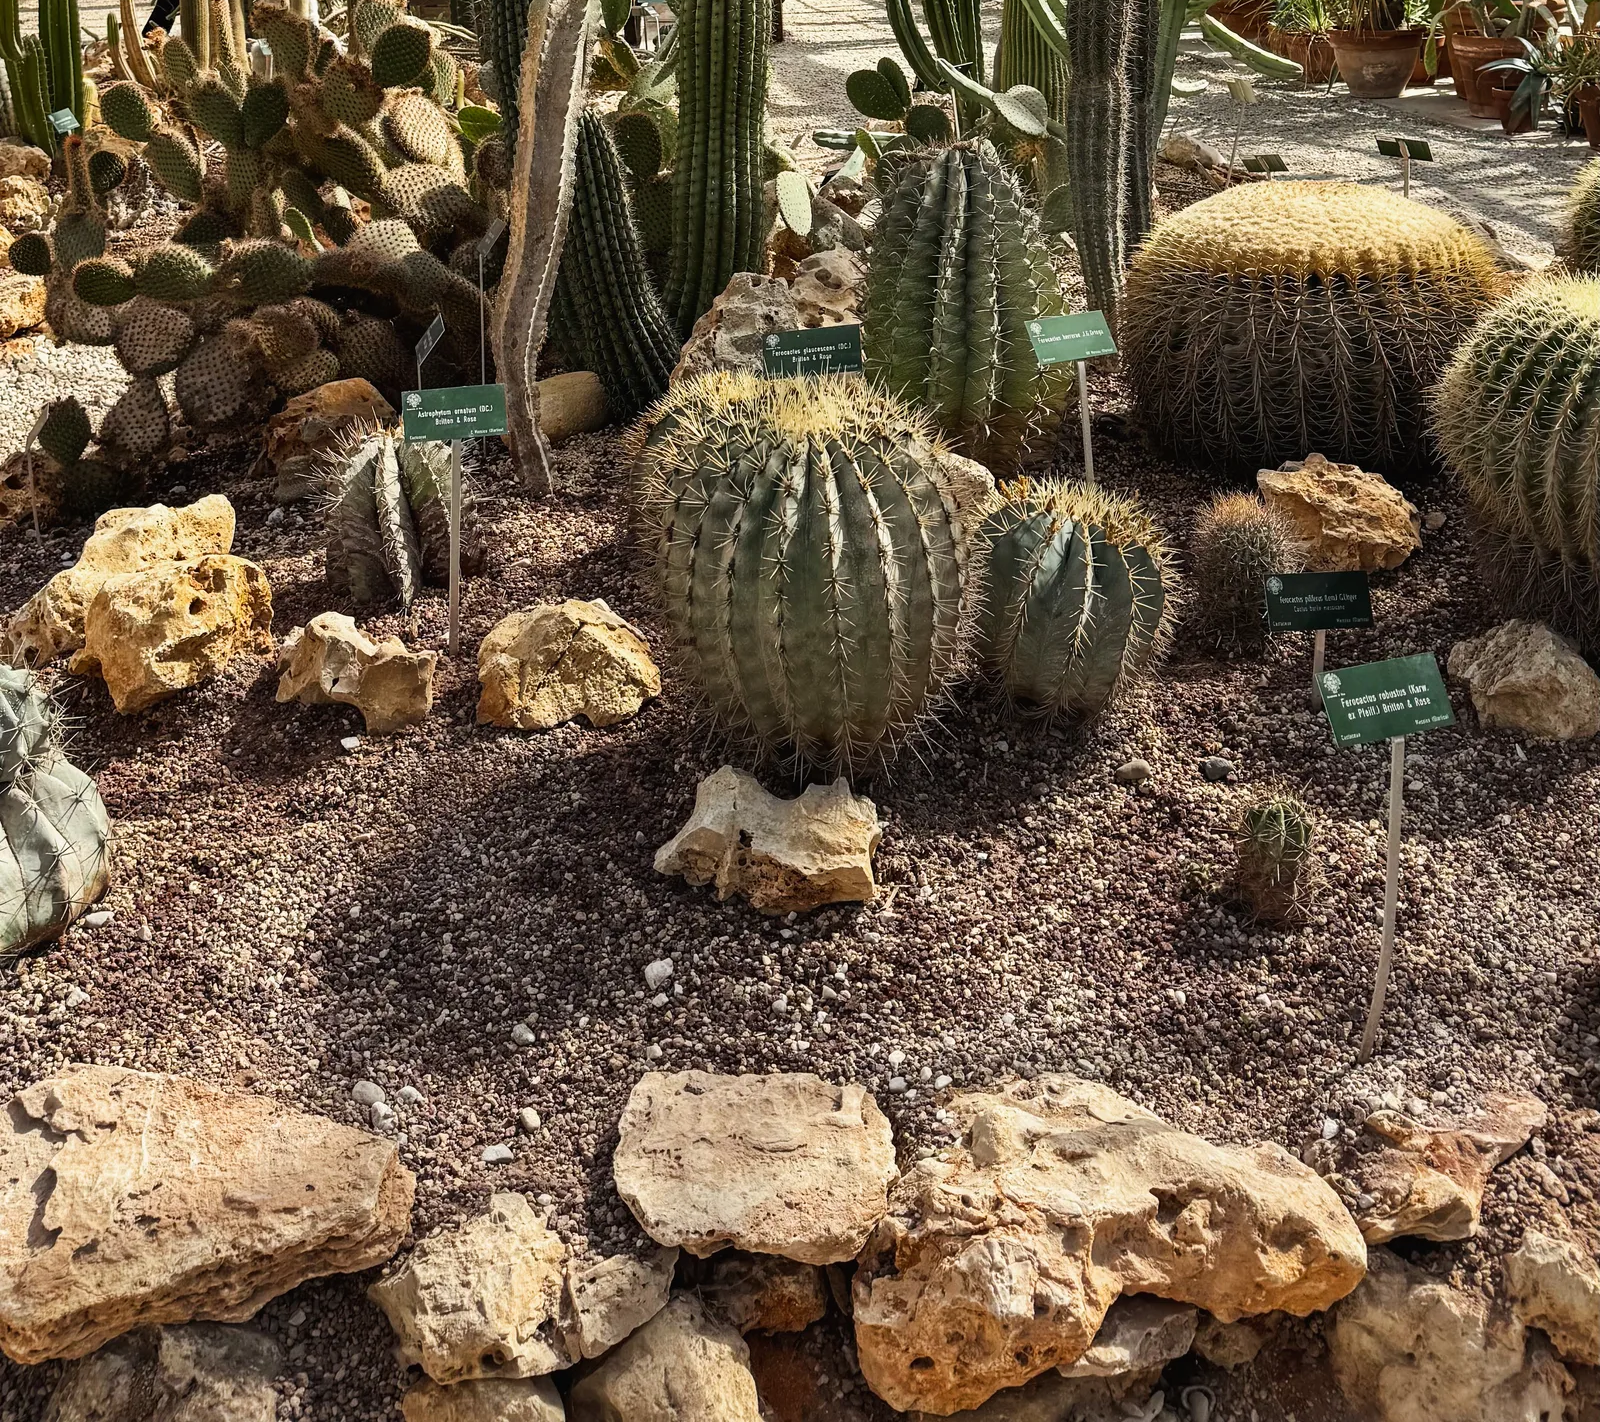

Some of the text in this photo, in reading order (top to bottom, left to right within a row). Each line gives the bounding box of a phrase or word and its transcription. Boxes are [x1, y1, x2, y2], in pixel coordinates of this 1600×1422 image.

[772, 342, 852, 357] Ferocactus glaucescens (DC.)
[417, 409, 451, 418] Astrophytum
[454, 407, 477, 415] ornatum
[479, 405, 493, 413] (DC.)
[435, 418, 454, 426] Britton
[1340, 694, 1377, 708] Ferocactus
[1378, 687, 1407, 701] robustus
[1408, 684, 1430, 695] (Karw.
[1347, 712, 1356, 720] ex
[1382, 702, 1405, 714] Britton
[1407, 699, 1413, 708] &
[1415, 696, 1431, 707] Rose
